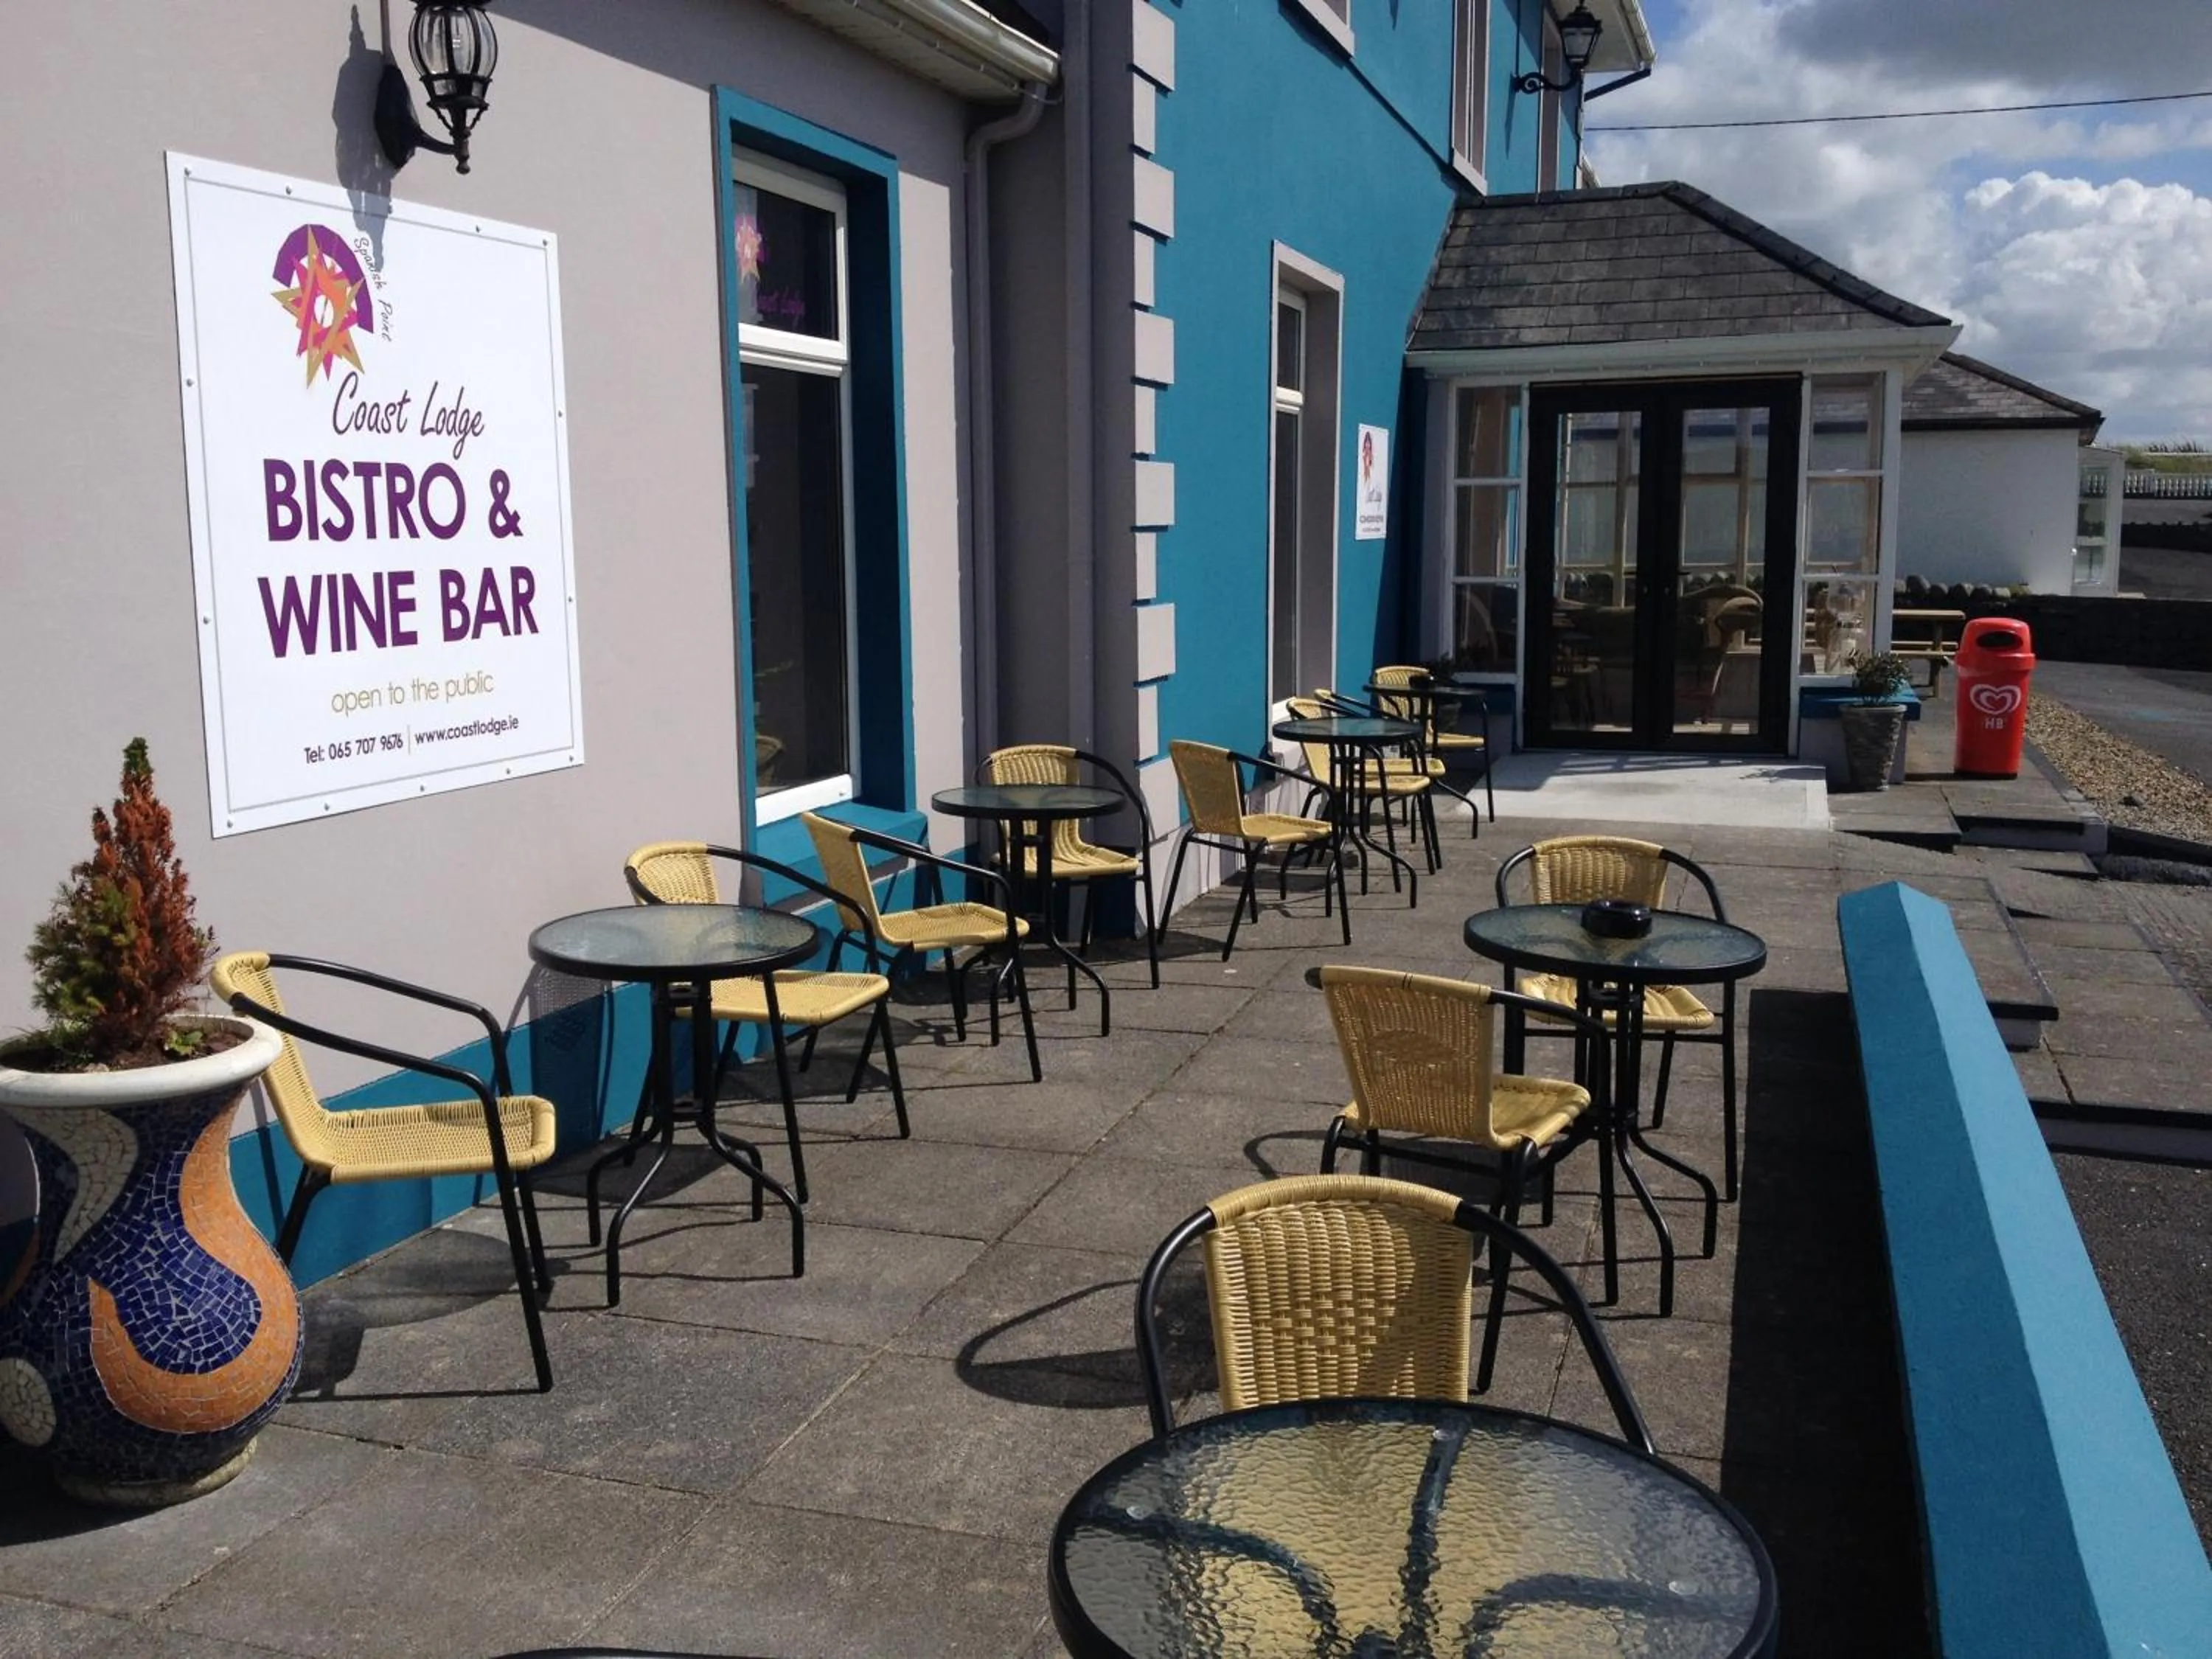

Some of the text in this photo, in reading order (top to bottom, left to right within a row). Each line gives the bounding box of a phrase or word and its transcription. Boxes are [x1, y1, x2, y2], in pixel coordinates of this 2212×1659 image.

[353, 236, 394, 344] Spanish Point
[333, 371, 485, 459] Coast Lodge
[262, 458, 524, 542] BISTRO &
[257, 566, 539, 658] WINE BAR
[331, 669, 495, 717] open to the public
[304, 714, 519, 765] Tel: 065 707 9676 www.coastlodge.ie
